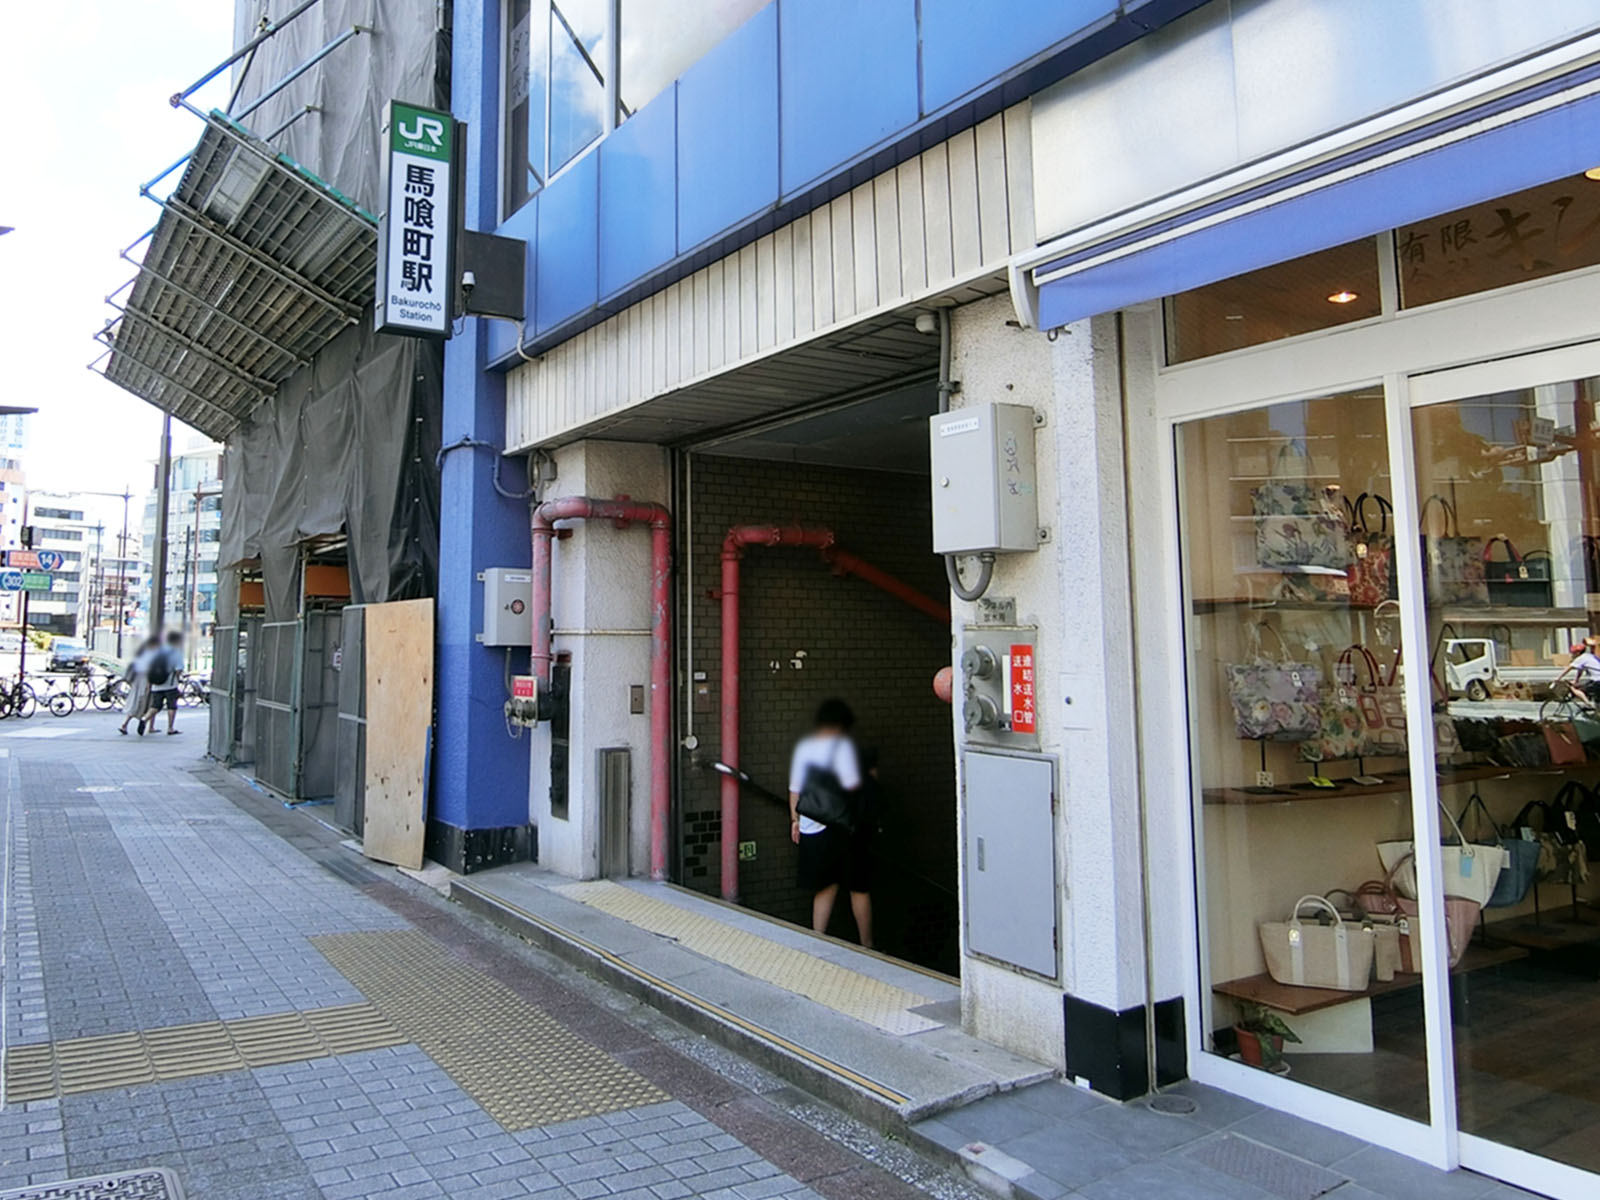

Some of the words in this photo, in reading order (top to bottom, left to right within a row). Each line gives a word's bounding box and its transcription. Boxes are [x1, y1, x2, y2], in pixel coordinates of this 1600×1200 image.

[399, 116, 443, 146] JR
[400, 163, 435, 293] 馬喰町駅
[399, 308, 433, 322] Station
[41, 553, 53, 565] 14
[6, 576, 22, 587] 302
[1013, 654, 1023, 723] 送水口
[1022, 654, 1033, 724] 連結送水管
